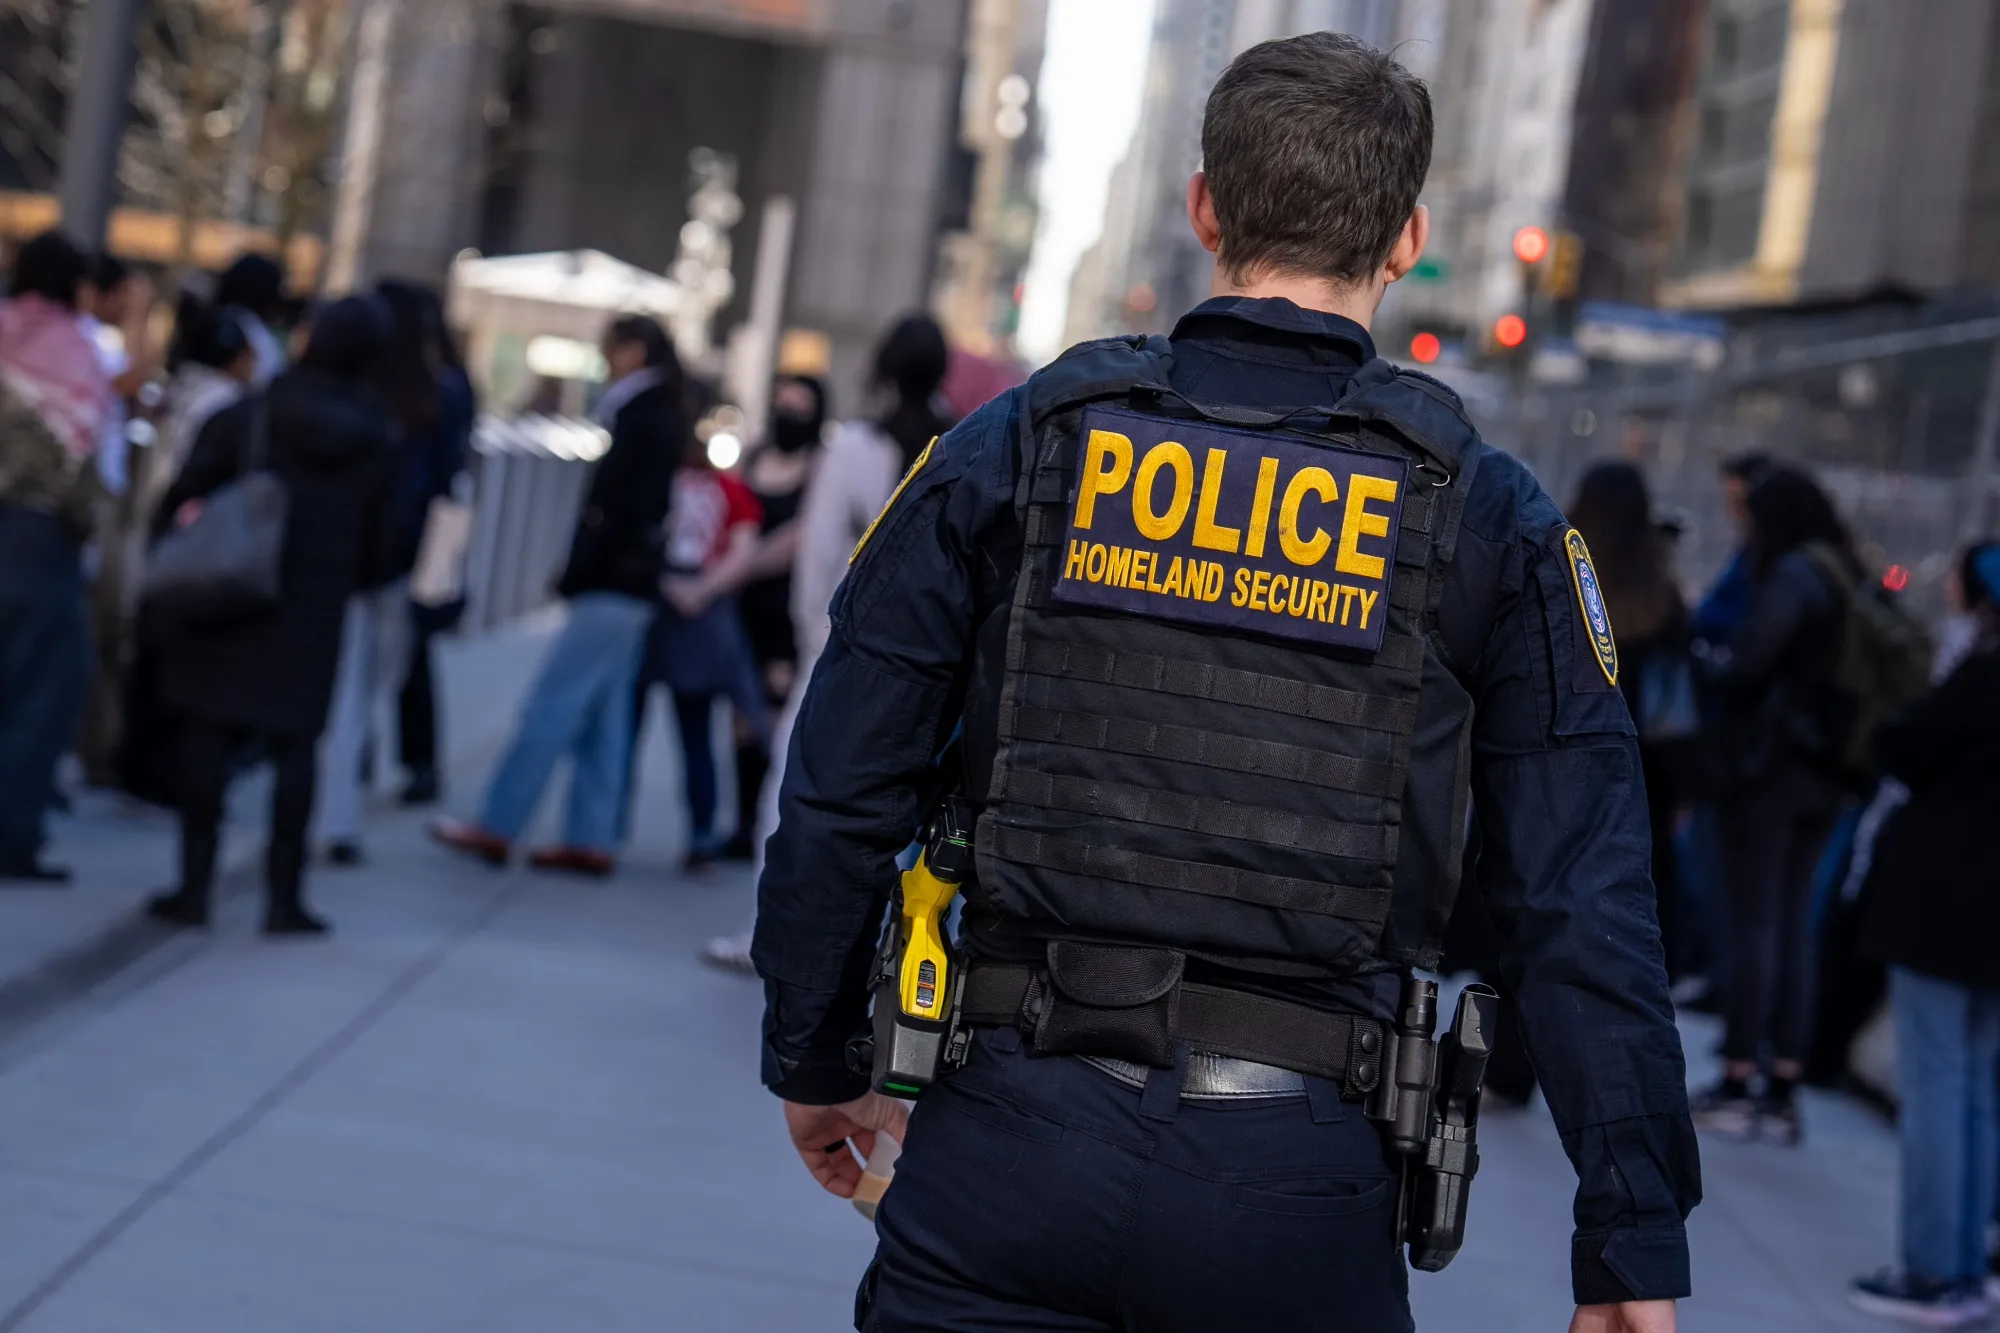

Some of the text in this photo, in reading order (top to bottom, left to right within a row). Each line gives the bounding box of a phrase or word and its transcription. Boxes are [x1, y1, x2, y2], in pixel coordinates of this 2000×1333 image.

[1074, 429, 1397, 579] POLICE
[1064, 539, 1378, 629] HOMELAND SECURITY
